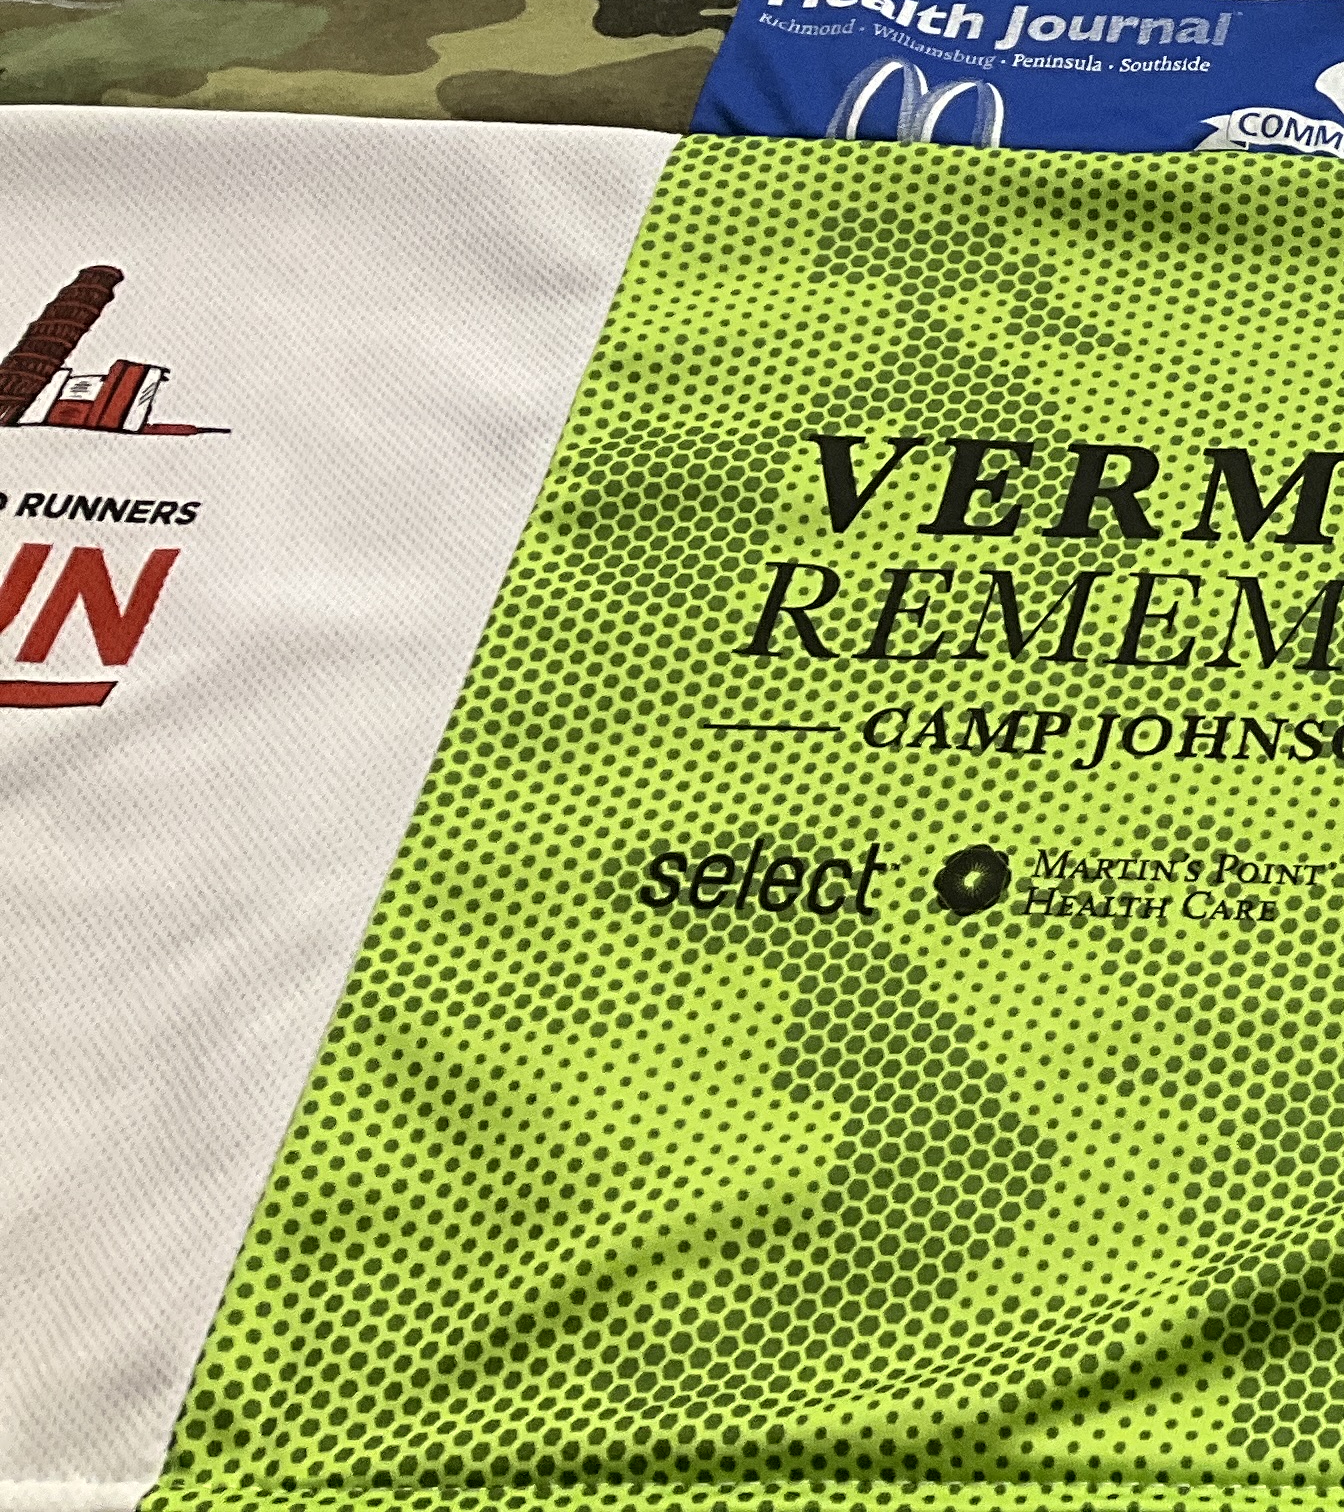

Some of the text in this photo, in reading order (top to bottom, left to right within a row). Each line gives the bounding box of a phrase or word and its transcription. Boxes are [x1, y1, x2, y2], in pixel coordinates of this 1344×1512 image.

[759, 12, 1212, 73] Richmond Williamsburg Peninsula Southside
[995, 5, 1233, 49] Journal
[15, 492, 201, 526] RUNNERS
[860, 706, 1072, 758] CAMP
[641, 840, 886, 916] select
[1029, 849, 1330, 886] MARTIN'S POINT
[1022, 887, 1278, 922] HEALTH CARE
